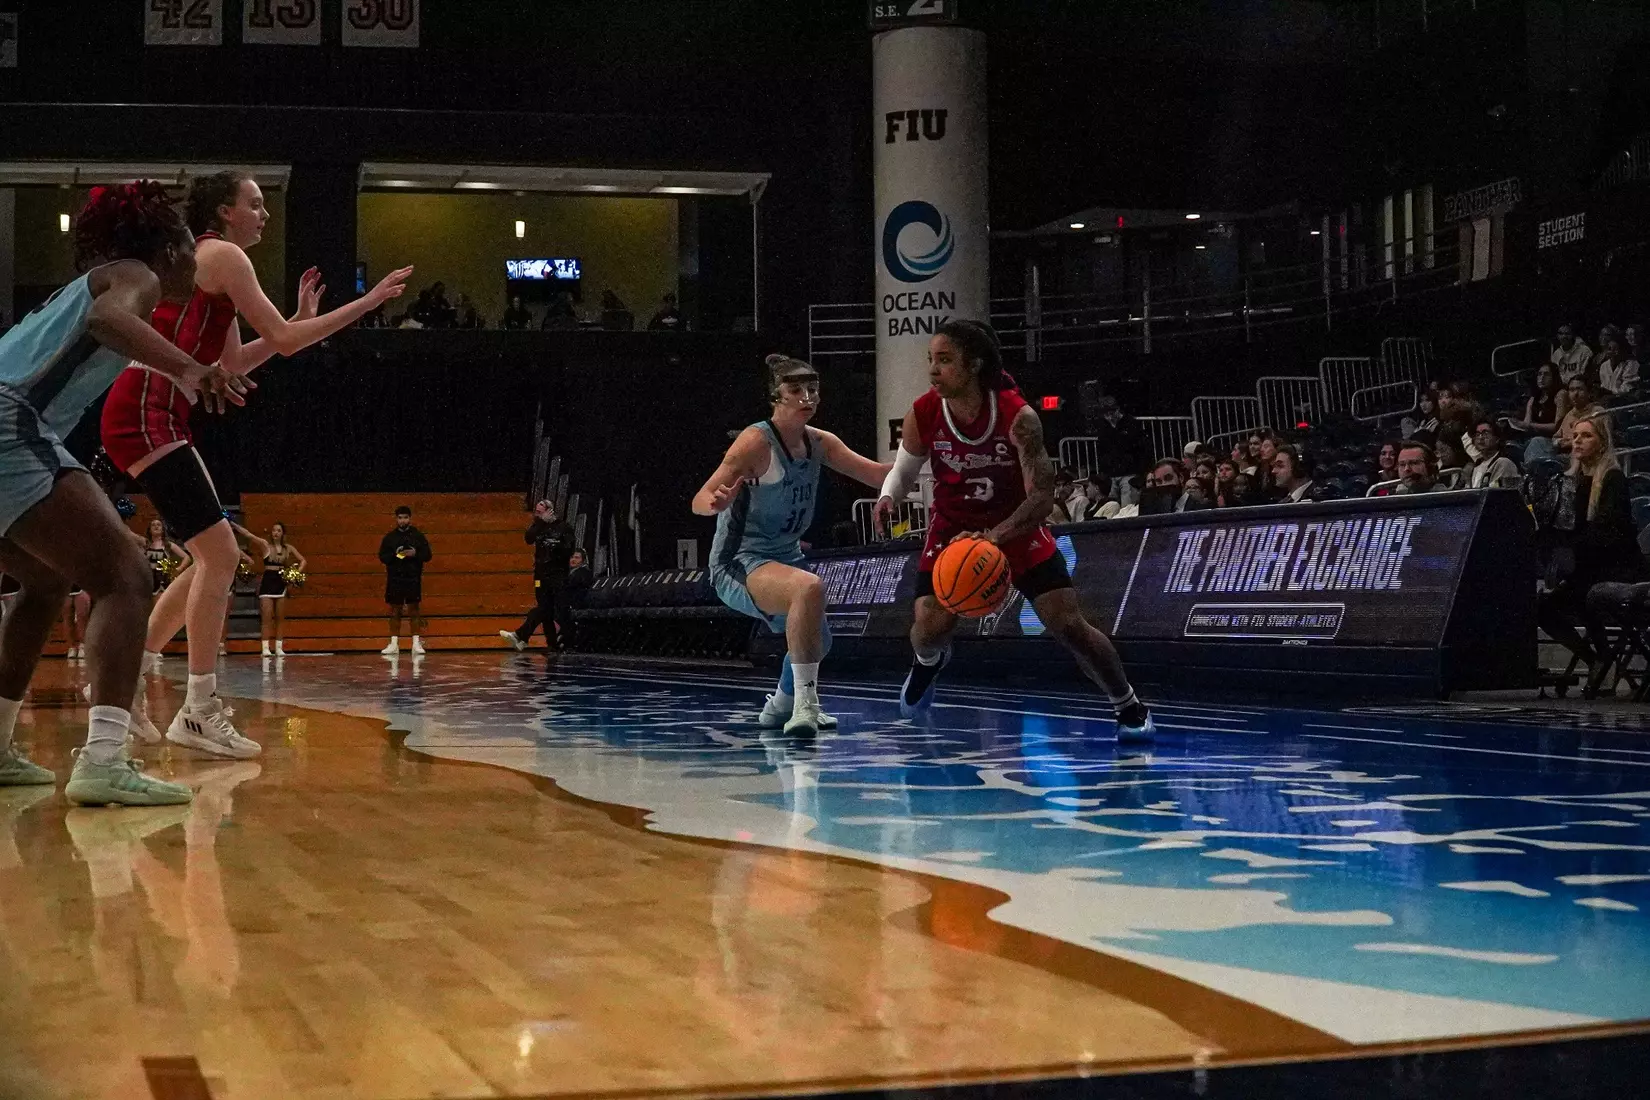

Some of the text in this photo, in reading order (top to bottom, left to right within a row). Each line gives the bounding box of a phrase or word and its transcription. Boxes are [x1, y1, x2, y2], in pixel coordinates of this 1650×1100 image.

[885, 109, 948, 144] FIU
[1538, 212, 1586, 236] STUDENT
[1538, 227, 1585, 249] SECTION
[882, 291, 956, 313] OCEAN
[888, 316, 950, 337] BANK
[964, 477, 995, 503] 3
[1163, 516, 1422, 592] THE PANTHER EXCHANGE
[1250, 614, 1265, 627] FIU
